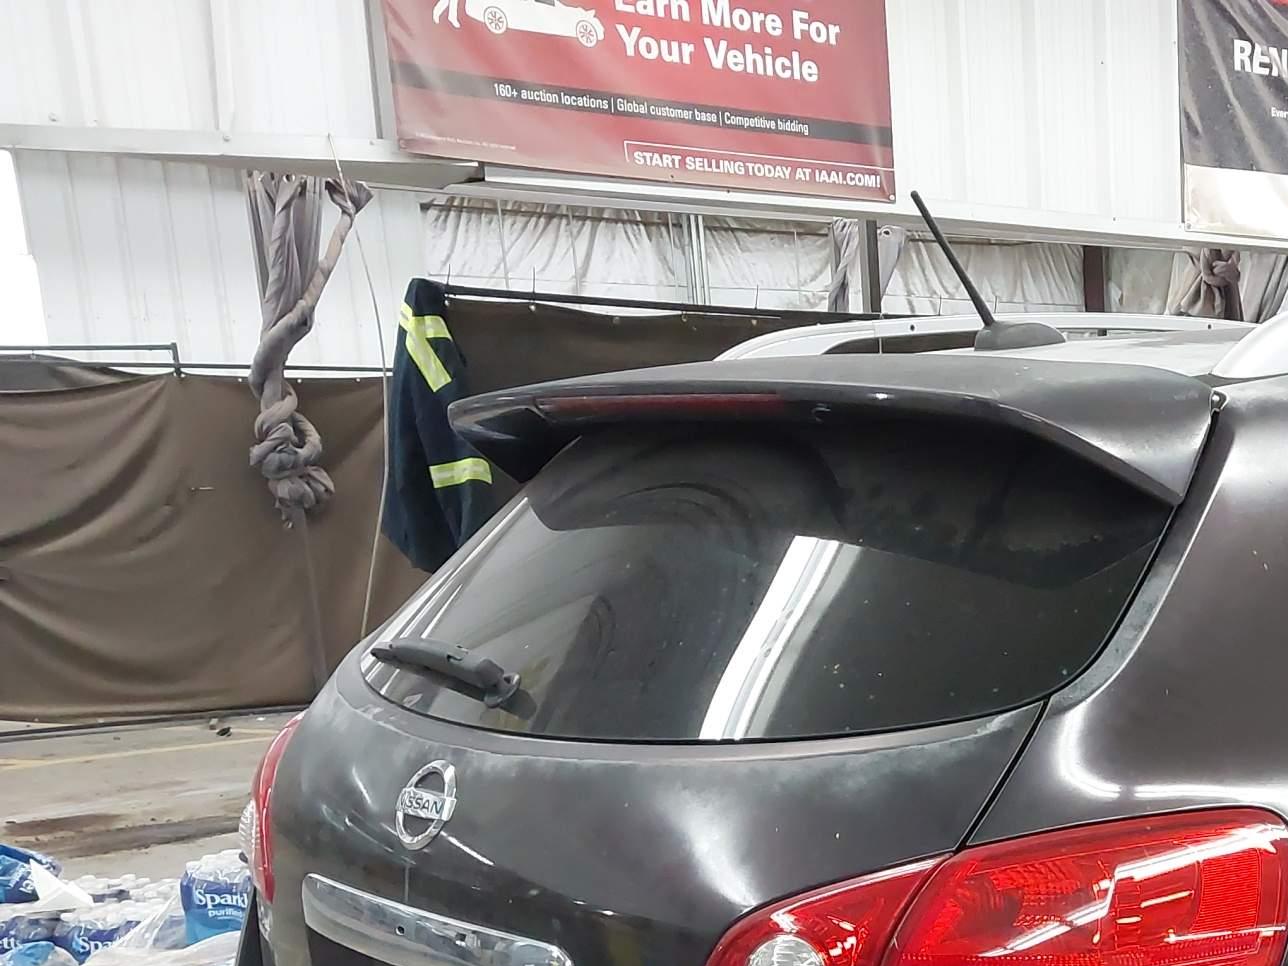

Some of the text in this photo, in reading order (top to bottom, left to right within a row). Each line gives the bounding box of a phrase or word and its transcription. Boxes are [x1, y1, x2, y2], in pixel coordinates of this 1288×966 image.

[701, 0, 783, 36] More
[792, 9, 841, 46] For
[615, 23, 819, 82] Your Vehicle
[493, 83, 518, 98] 160+
[520, 89, 559, 103] auction
[561, 92, 609, 110] locations
[616, 98, 648, 114] Global
[650, 104, 693, 120] customer
[694, 108, 717, 123] base
[724, 112, 776, 129] Competitive
[777, 118, 809, 136] bidding
[633, 151, 881, 188] START SELLING TODAY AT IAAI.COM!
